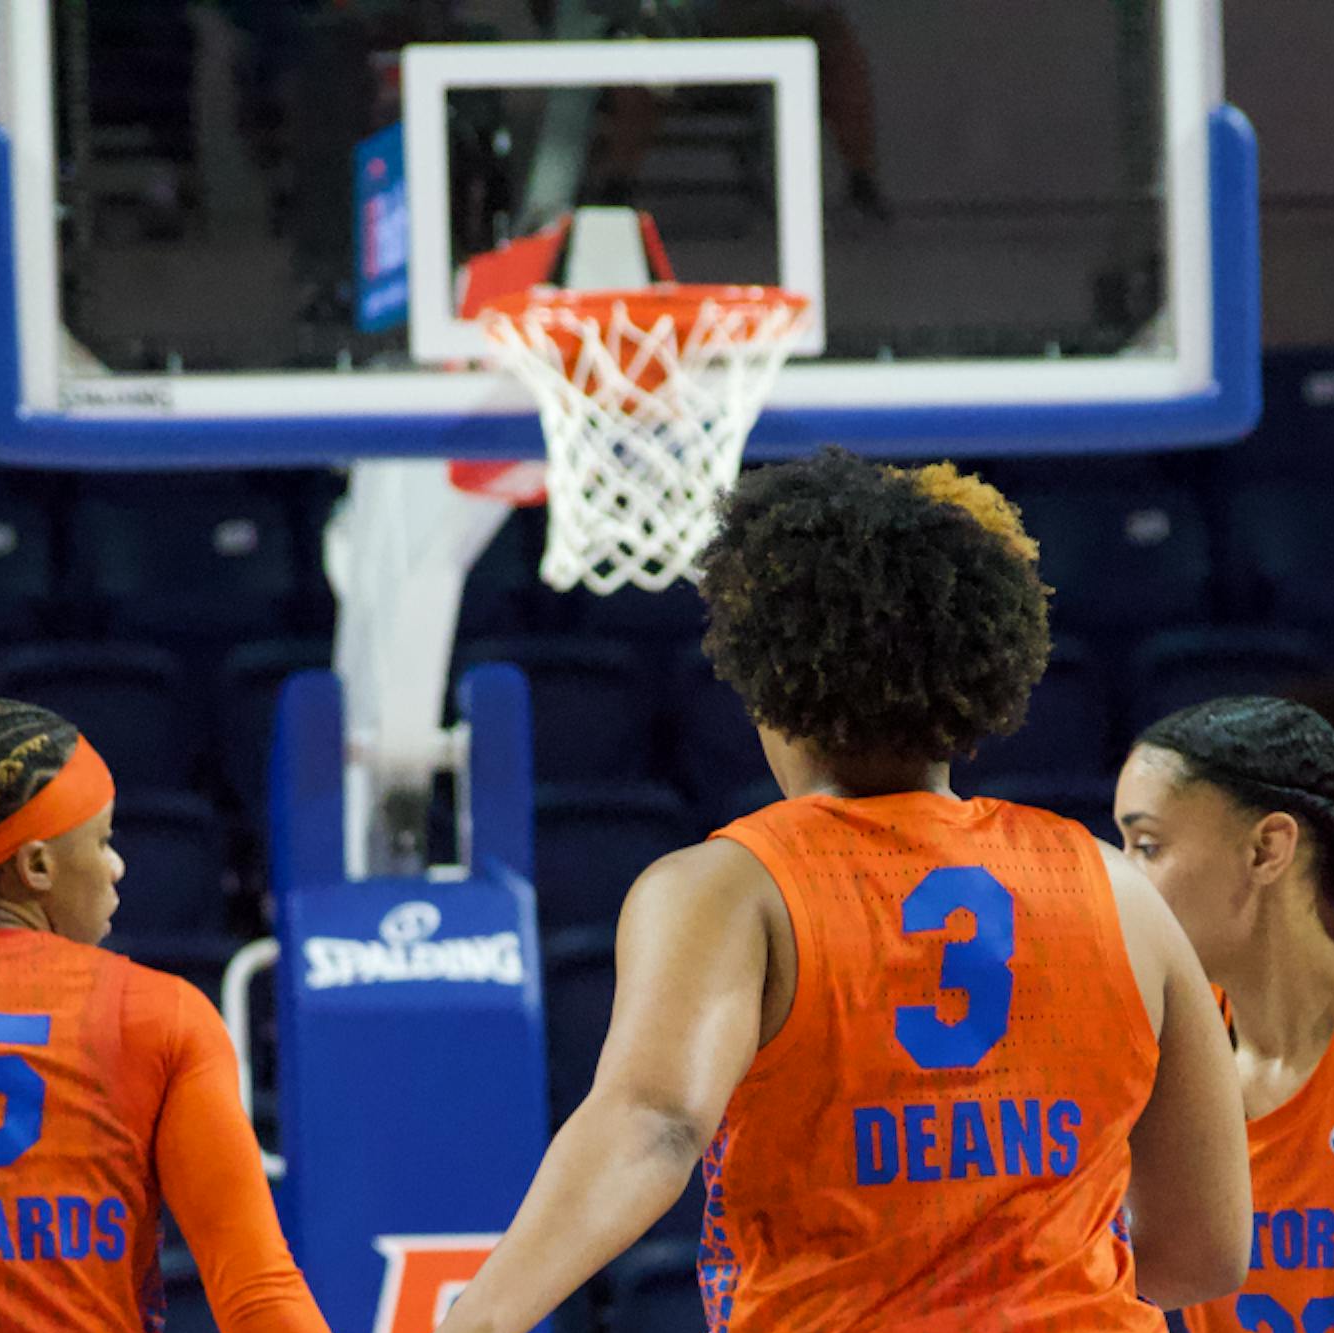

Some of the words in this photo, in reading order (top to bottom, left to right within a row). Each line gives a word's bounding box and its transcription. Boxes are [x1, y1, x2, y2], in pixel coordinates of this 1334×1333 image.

[303, 932, 523, 990] SPALDING
[895, 866, 1014, 1069] 3
[854, 1100, 1083, 1187] DEANS
